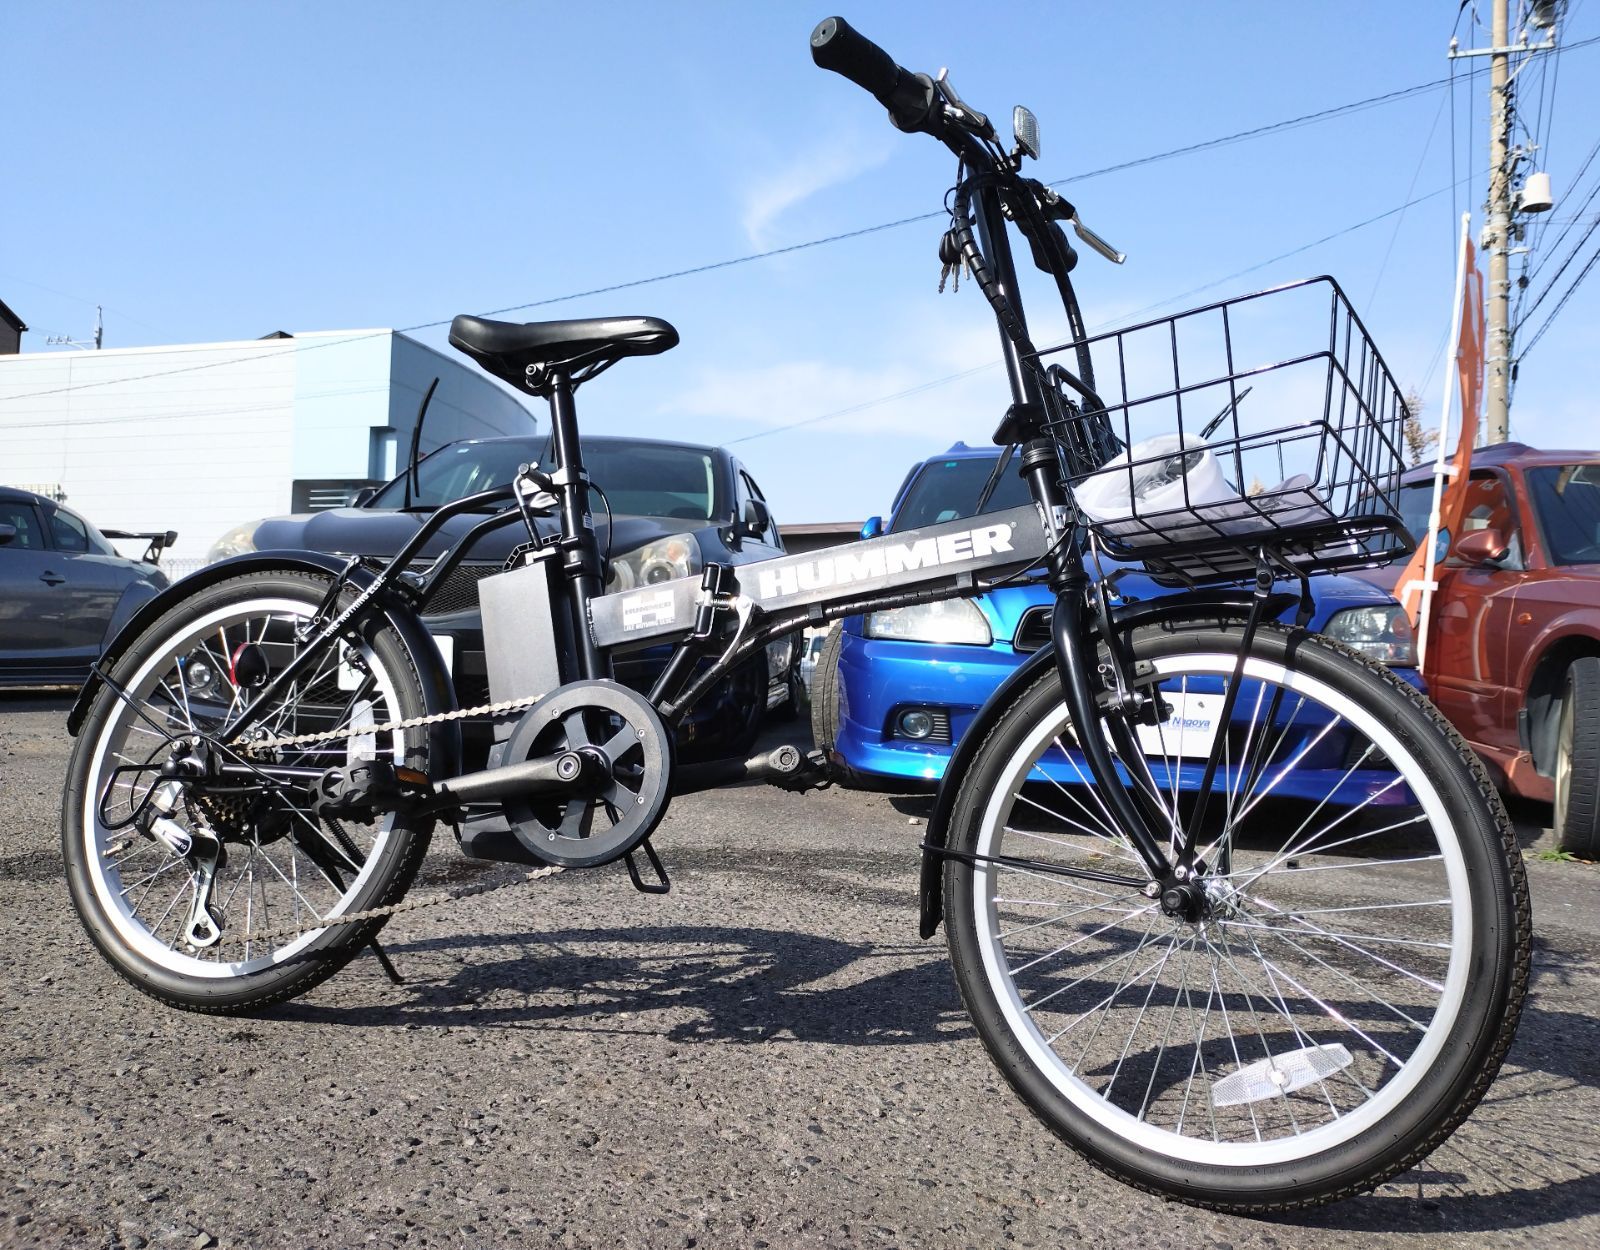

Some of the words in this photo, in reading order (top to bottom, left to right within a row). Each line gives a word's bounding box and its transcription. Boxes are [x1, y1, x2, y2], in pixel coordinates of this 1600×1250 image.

[758, 523, 1014, 599] HUMMER
[323, 619, 341, 637] LIKE
[339, 591, 369, 622] NOTHING
